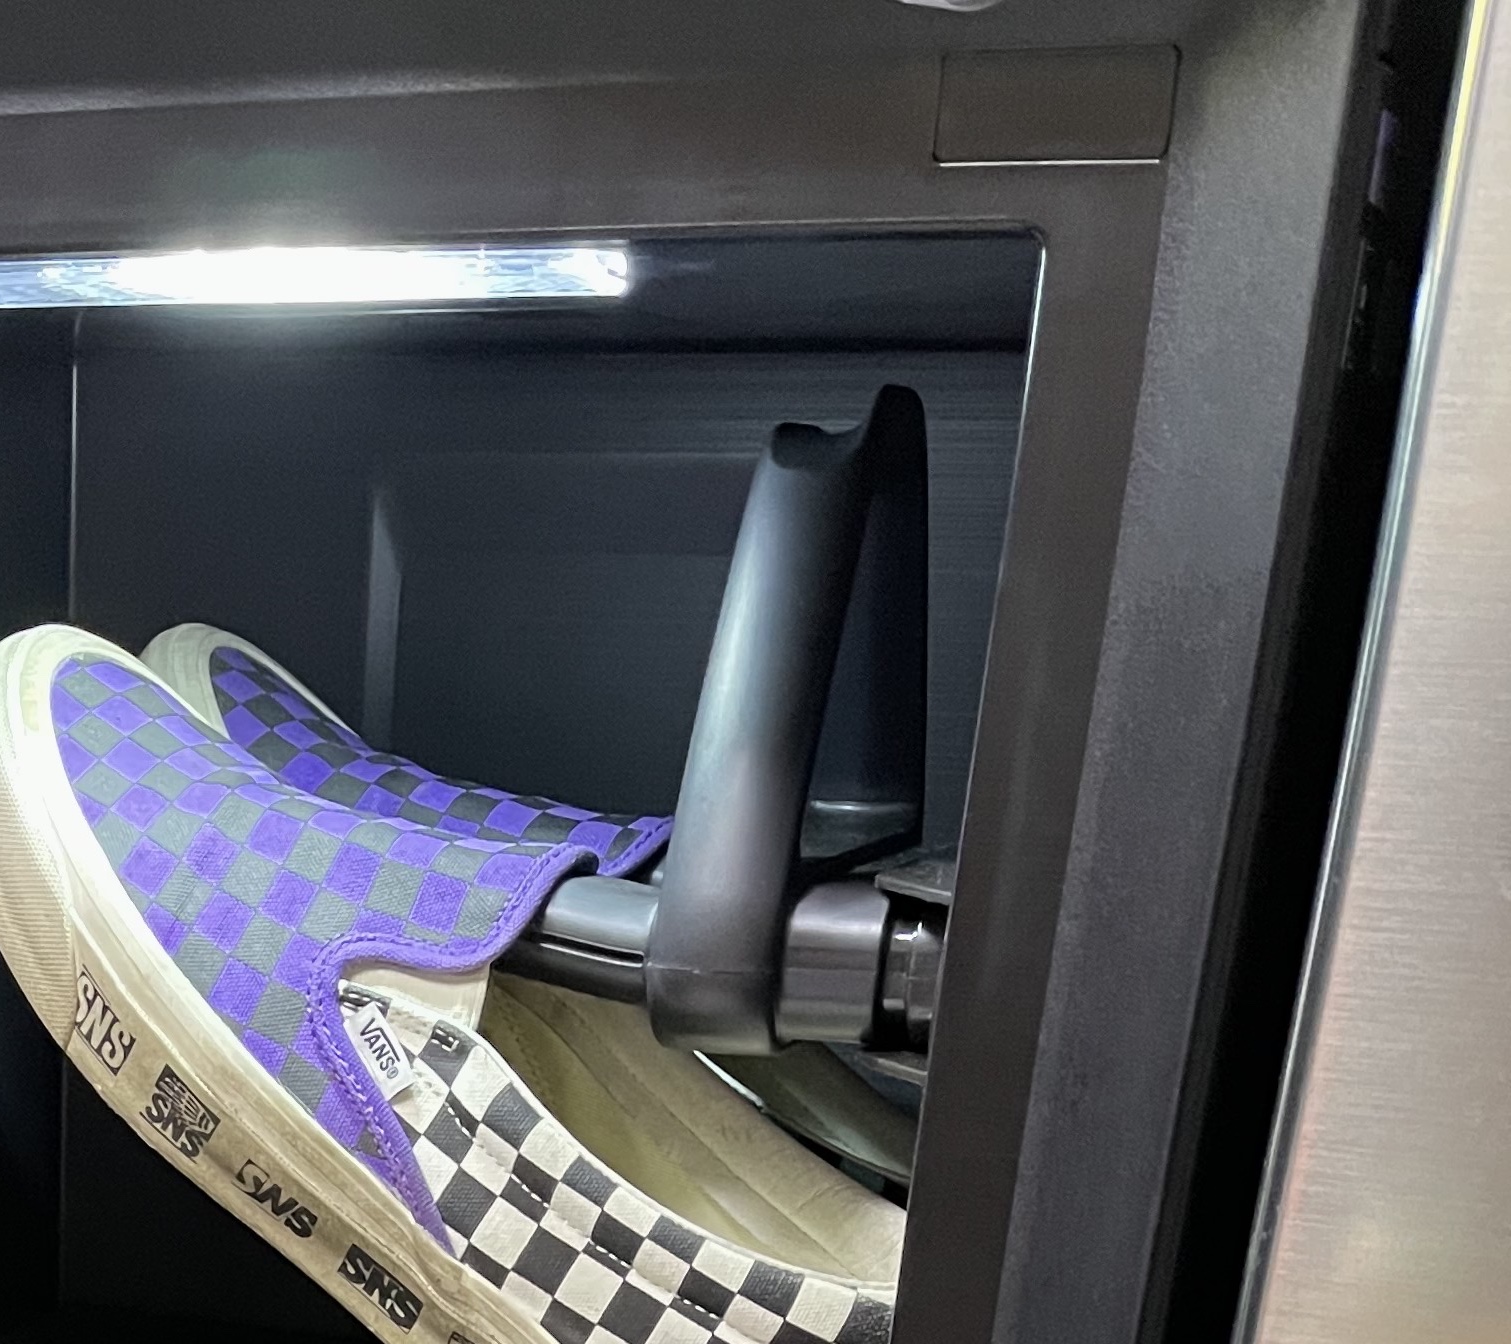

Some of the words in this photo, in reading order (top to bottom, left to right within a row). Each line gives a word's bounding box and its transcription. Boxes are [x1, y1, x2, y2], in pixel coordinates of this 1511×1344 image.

[76, 975, 131, 1069] SNS
[145, 1093, 204, 1158] SNS
[233, 1162, 318, 1238] SNS
[338, 1245, 422, 1331] SNS
